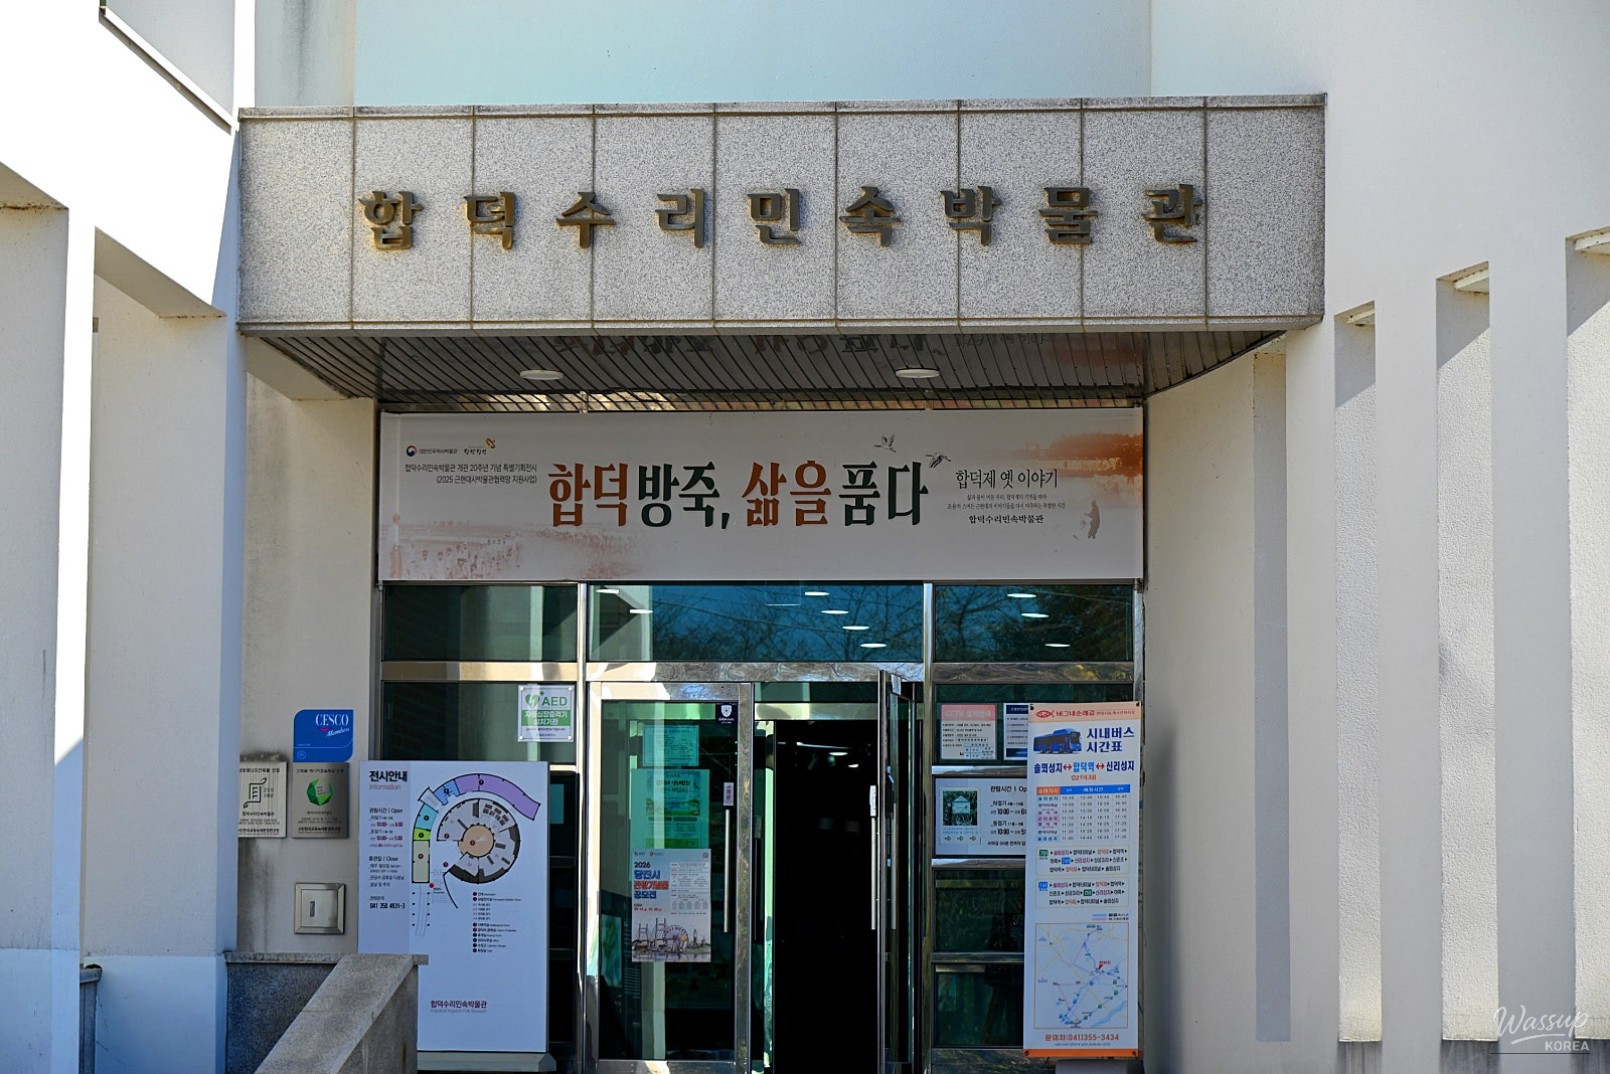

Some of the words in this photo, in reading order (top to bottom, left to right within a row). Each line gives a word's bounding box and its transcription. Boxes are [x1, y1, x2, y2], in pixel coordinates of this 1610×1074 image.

[358, 184, 1207, 250] 합덕수리민속박물관
[405, 464, 456, 472] 합덕수리민속박물관
[457, 464, 468, 472] 개관
[470, 464, 489, 472] 20주년
[490, 464, 502, 472] 기념
[502, 463, 538, 472] 특별기획전시
[436, 475, 454, 484] (2025
[956, 469, 996, 489] 합덕제
[1000, 469, 1014, 490] 옛
[1018, 468, 1058, 488] 이야기
[548, 461, 730, 529] 합덕방죽,
[741, 460, 832, 527] 삶을
[838, 461, 929, 526] 품다
[968, 515, 1044, 524] 합덕수리민속박물관
[542, 697, 568, 706] AED
[316, 714, 349, 726] CESCO
[1086, 726, 1134, 739] 시내버스
[1086, 740, 1122, 752] 시간표
[1034, 763, 1062, 774] 솔뫼성지
[1073, 762, 1095, 772] 합덕역
[1106, 760, 1134, 772] 신리성지
[369, 770, 408, 782] 전시안내
[634, 870, 660, 880] 당진시
[431, 1000, 487, 1008] 합덕수리민속박물관
